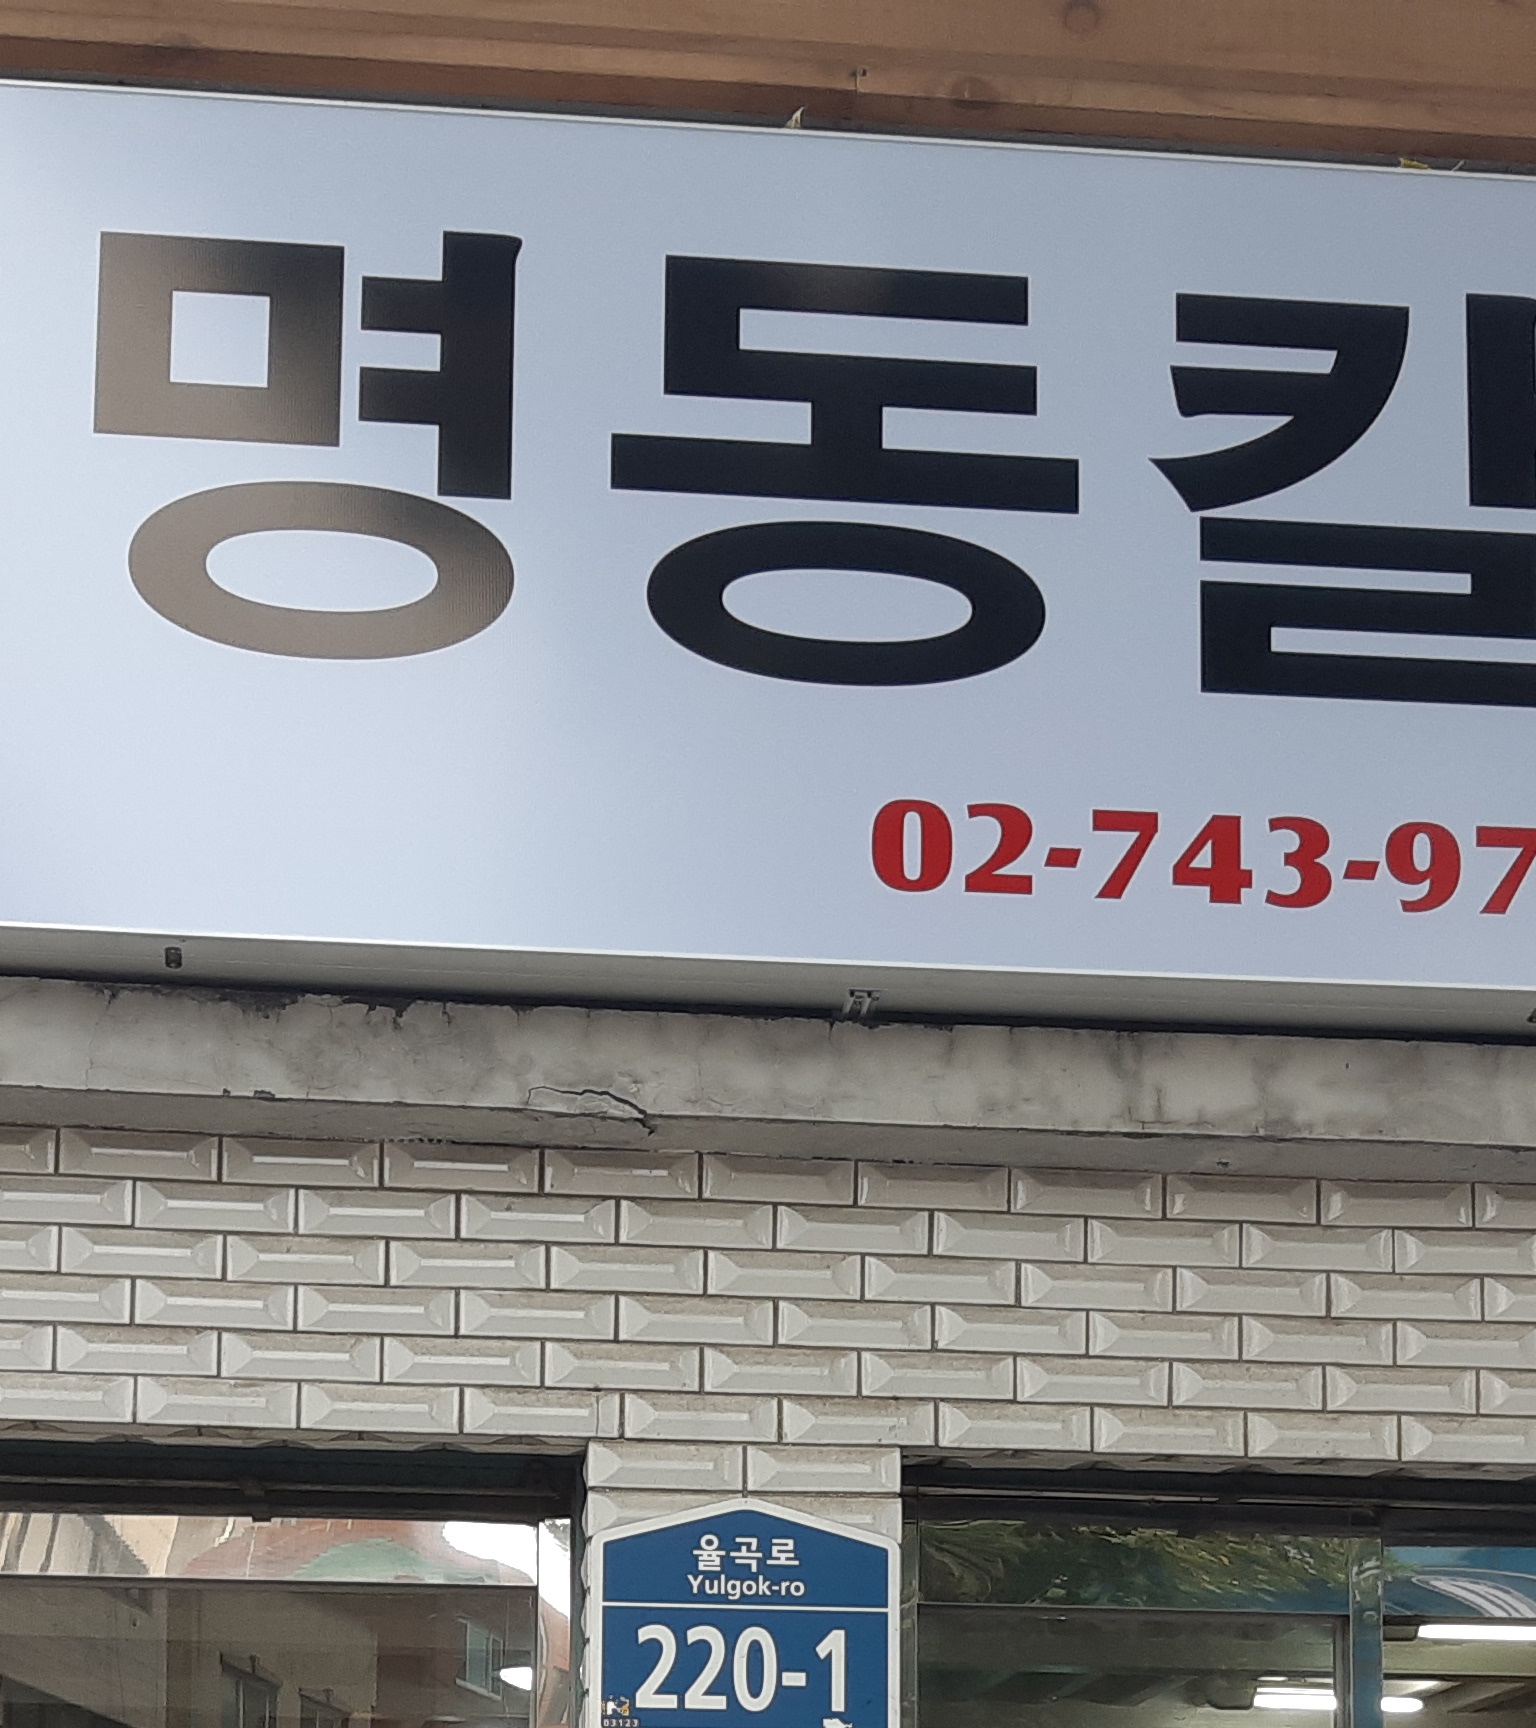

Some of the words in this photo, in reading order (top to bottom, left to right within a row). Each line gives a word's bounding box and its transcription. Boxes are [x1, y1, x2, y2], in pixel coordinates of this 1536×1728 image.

[692, 1534, 800, 1572] 율곡로
[687, 1574, 806, 1600] Yulgok-ro
[635, 1624, 847, 1713] 220-1
